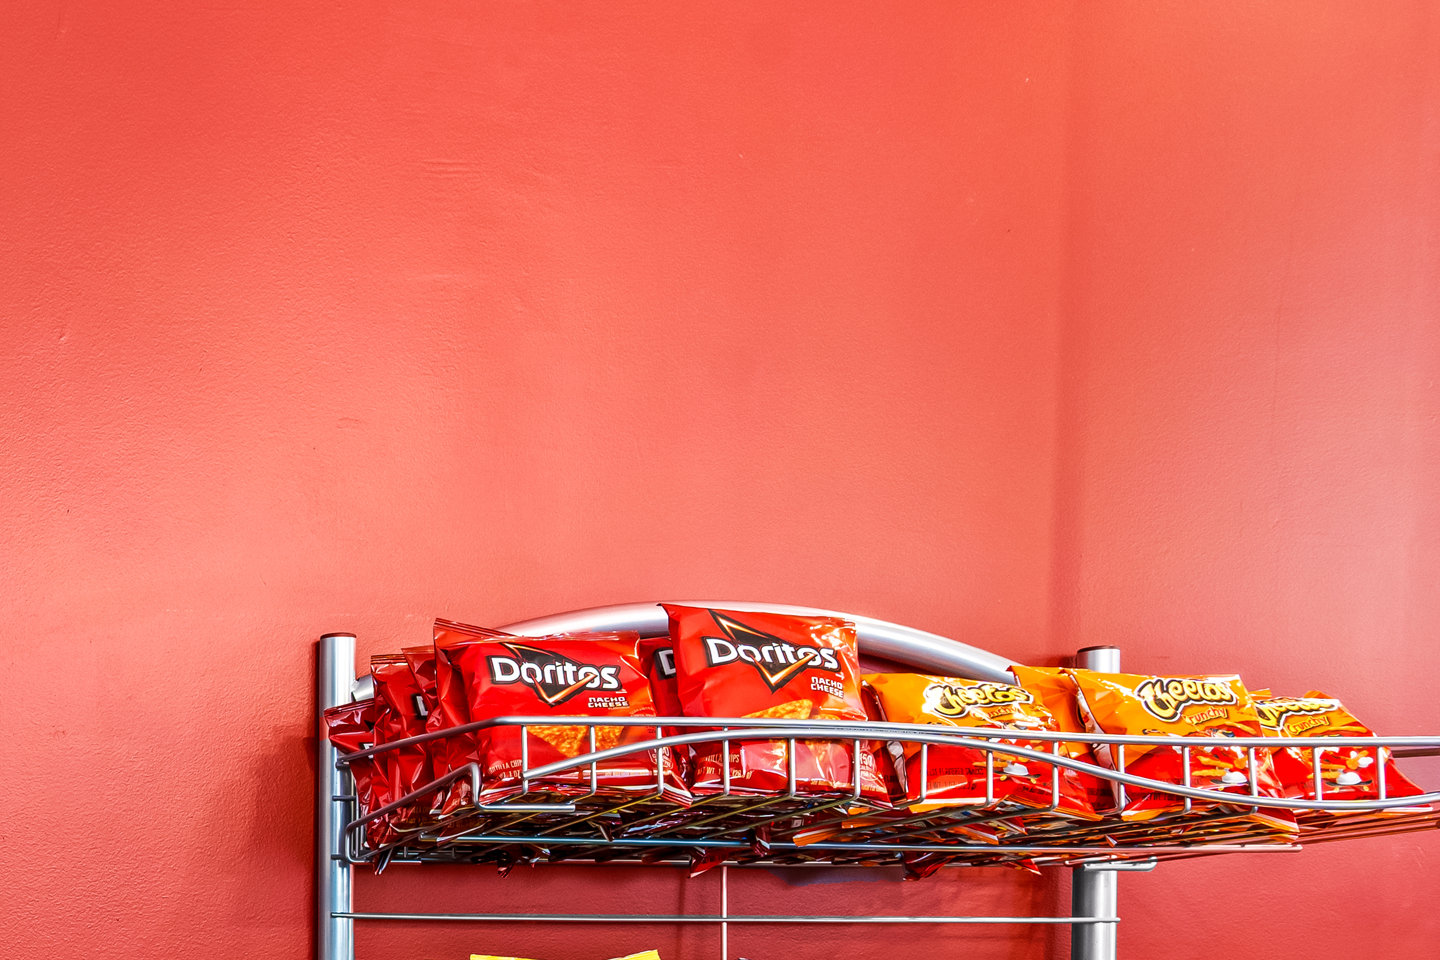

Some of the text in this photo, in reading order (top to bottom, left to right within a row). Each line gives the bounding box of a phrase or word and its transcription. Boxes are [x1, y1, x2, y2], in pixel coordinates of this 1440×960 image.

[706, 638, 840, 670] Doritos
[491, 656, 620, 689] Doritos
[811, 677, 843, 690] NACHO
[811, 684, 844, 698] CHEESE
[926, 685, 1032, 716] Cheetos
[1137, 678, 1235, 721] Cheetos
[1287, 715, 1329, 735] Crunchy
[860, 753, 872, 766] 150
